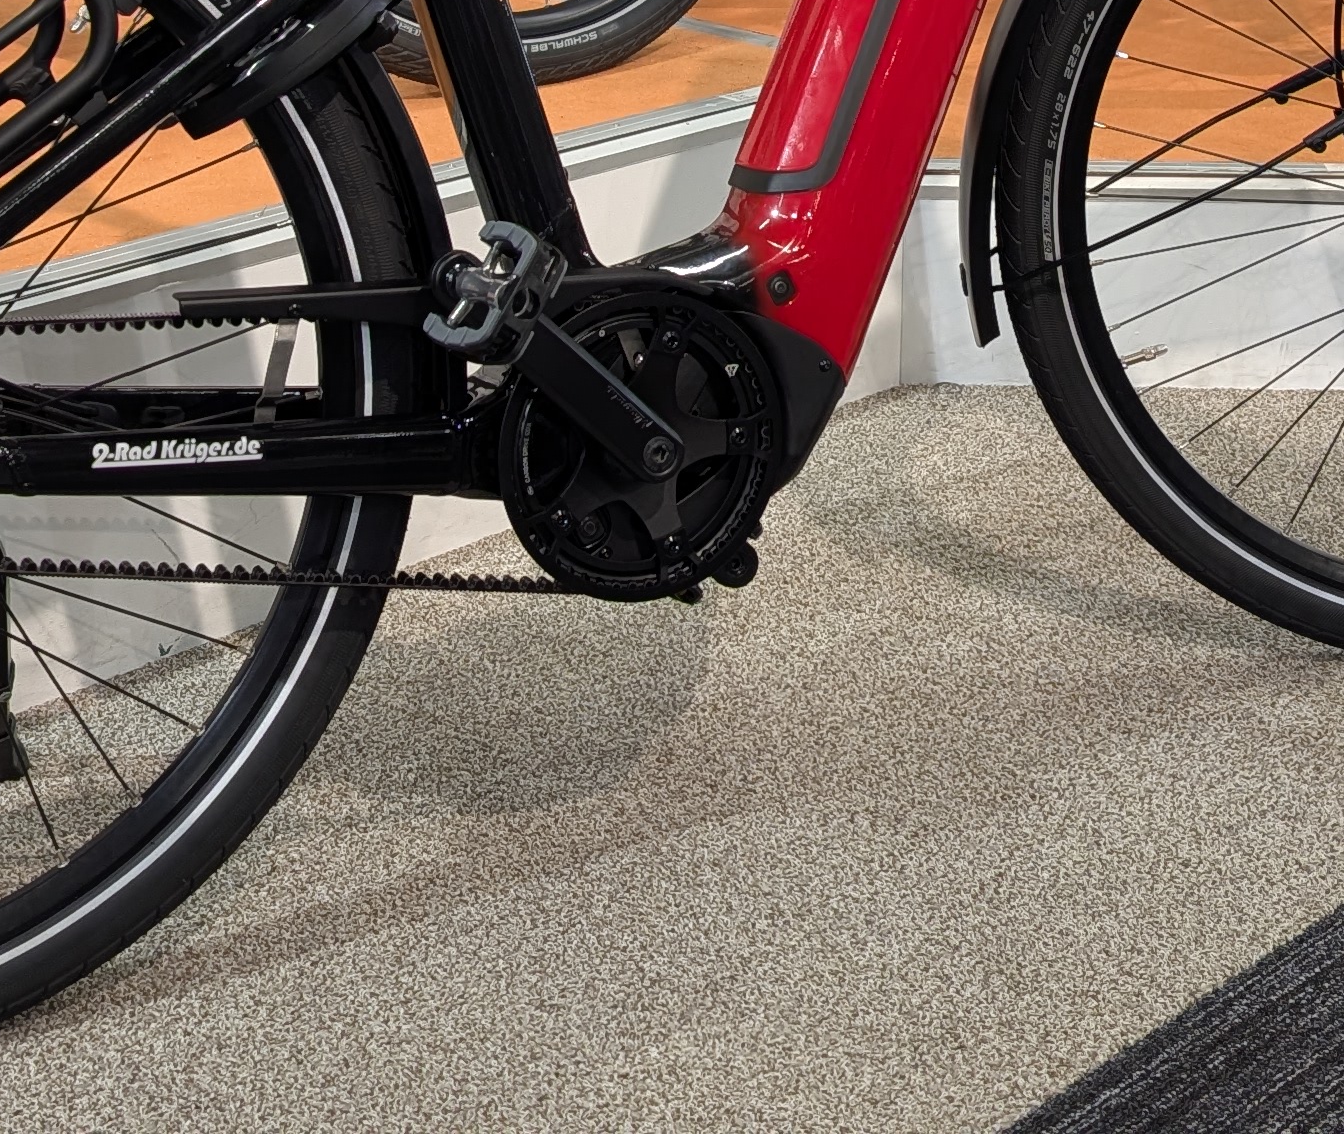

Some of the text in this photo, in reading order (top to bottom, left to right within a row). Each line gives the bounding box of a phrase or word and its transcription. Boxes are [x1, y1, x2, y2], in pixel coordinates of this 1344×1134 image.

[530, 30, 598, 54] SCHWALBE
[1062, 9, 1095, 80] 47-622
[91, 435, 261, 468] 2-Rad Krüger.de
